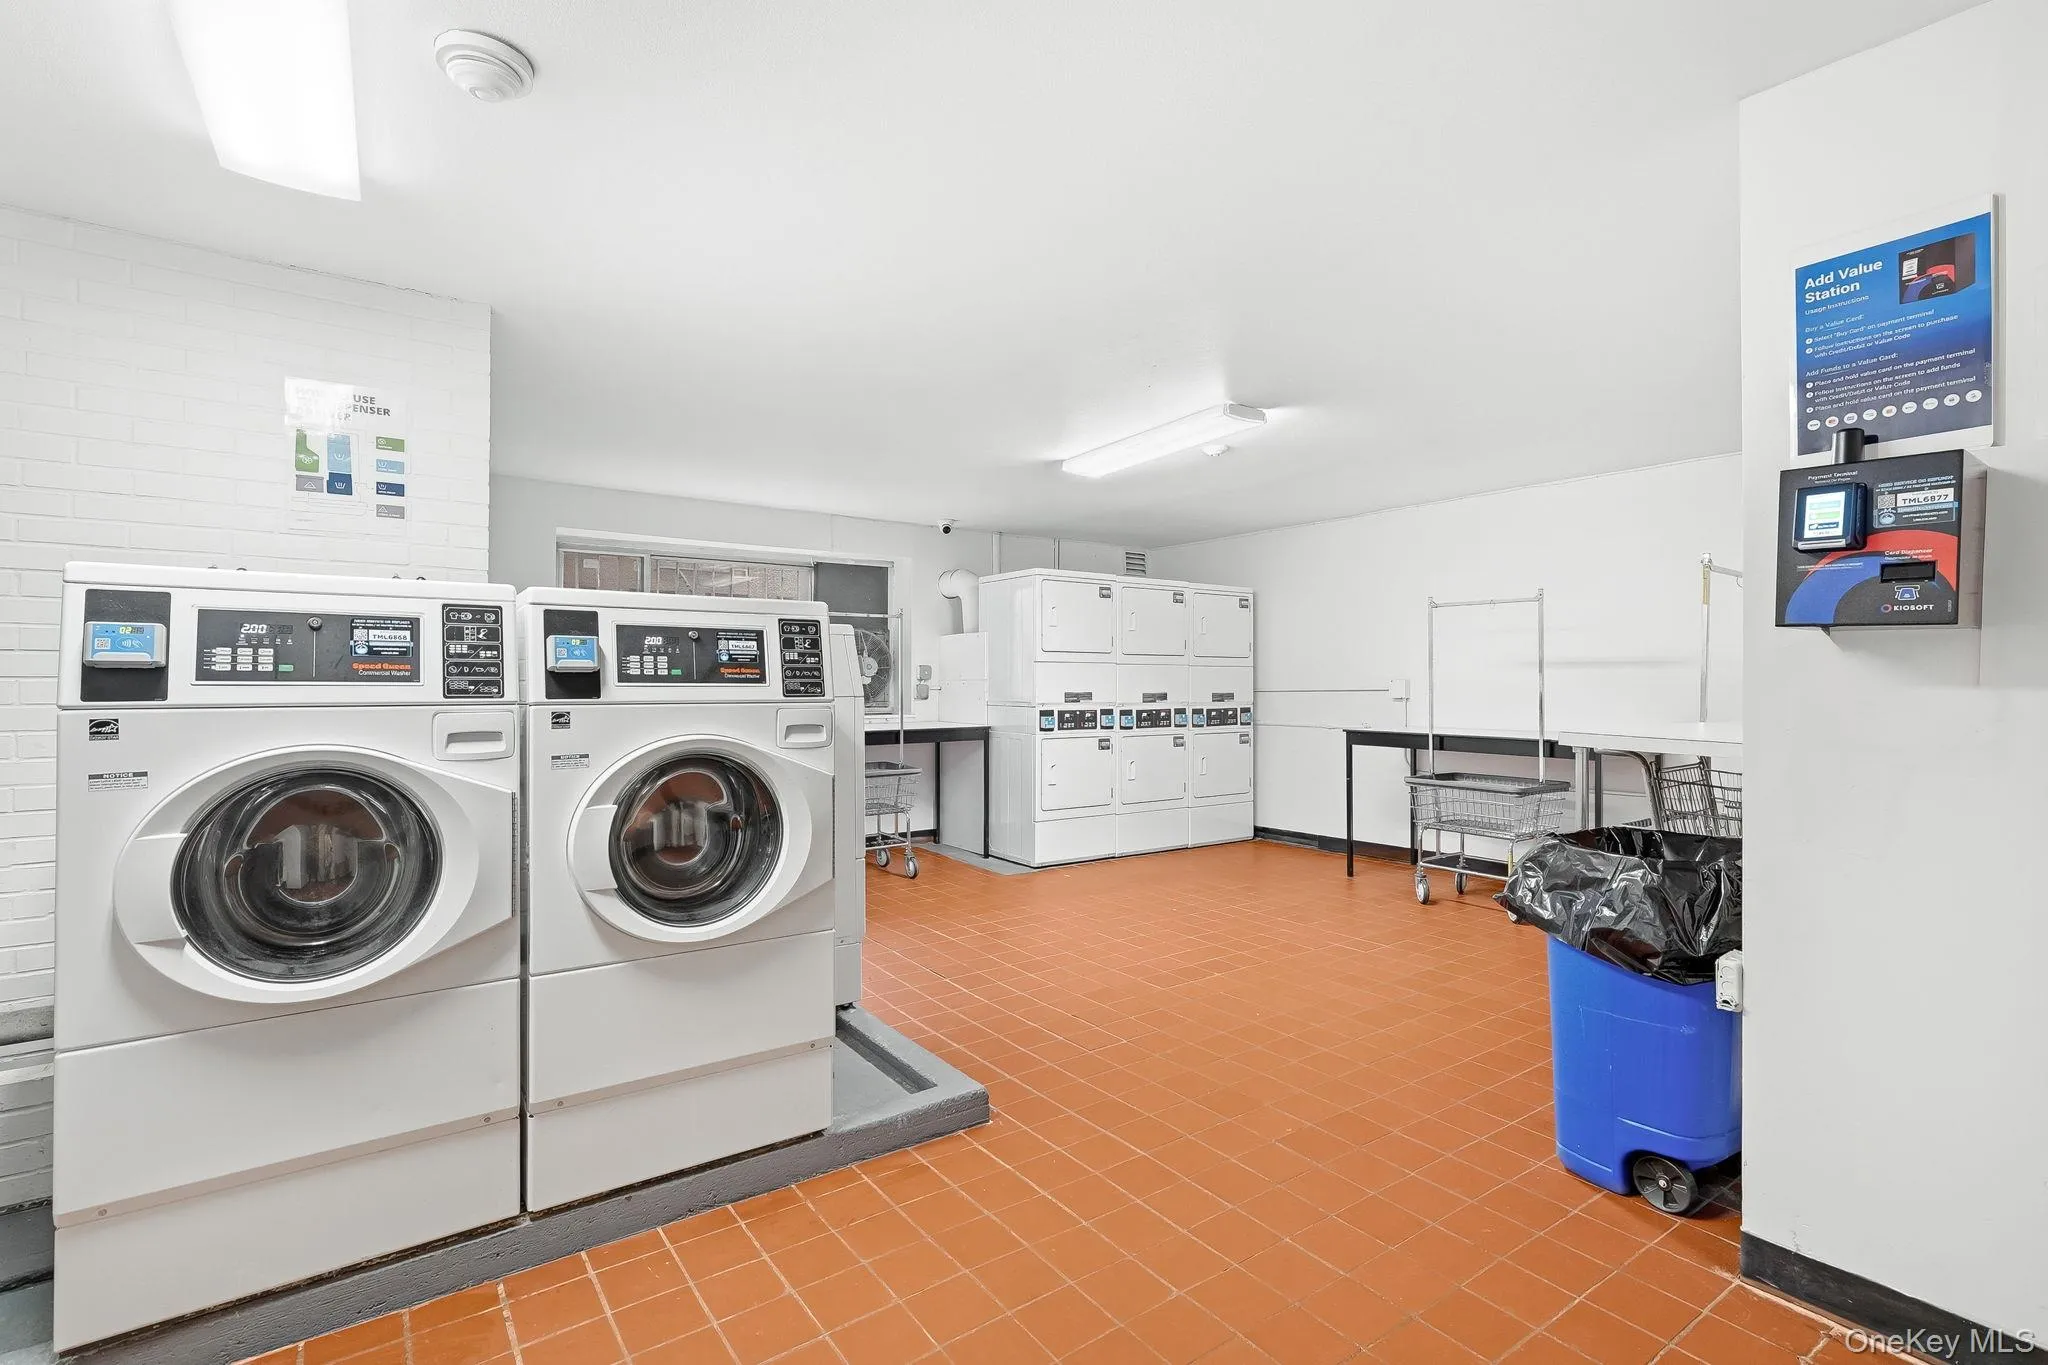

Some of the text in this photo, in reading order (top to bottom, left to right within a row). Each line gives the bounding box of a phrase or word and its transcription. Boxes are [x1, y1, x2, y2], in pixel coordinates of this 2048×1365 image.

[1805, 261, 1883, 289] Add Value
[1805, 282, 1860, 303] Station
[1814, 334, 1832, 343] Select
[1877, 316, 1905, 328] payment
[1906, 309, 1934, 320] terminal
[1895, 325, 1916, 334] screen
[1926, 315, 1958, 328] purchase
[1821, 365, 1841, 374] Funds
[1879, 353, 1898, 361] Card:
[1915, 355, 1945, 366] payment
[1946, 348, 1975, 358] terminal
[1895, 371, 1916, 380] screen
[1941, 362, 1961, 371] funds
[1915, 382, 1946, 393] payment
[1946, 376, 1976, 386] terminal
[353, 394, 376, 404] USE
[1902, 494, 1948, 504] TML6877
